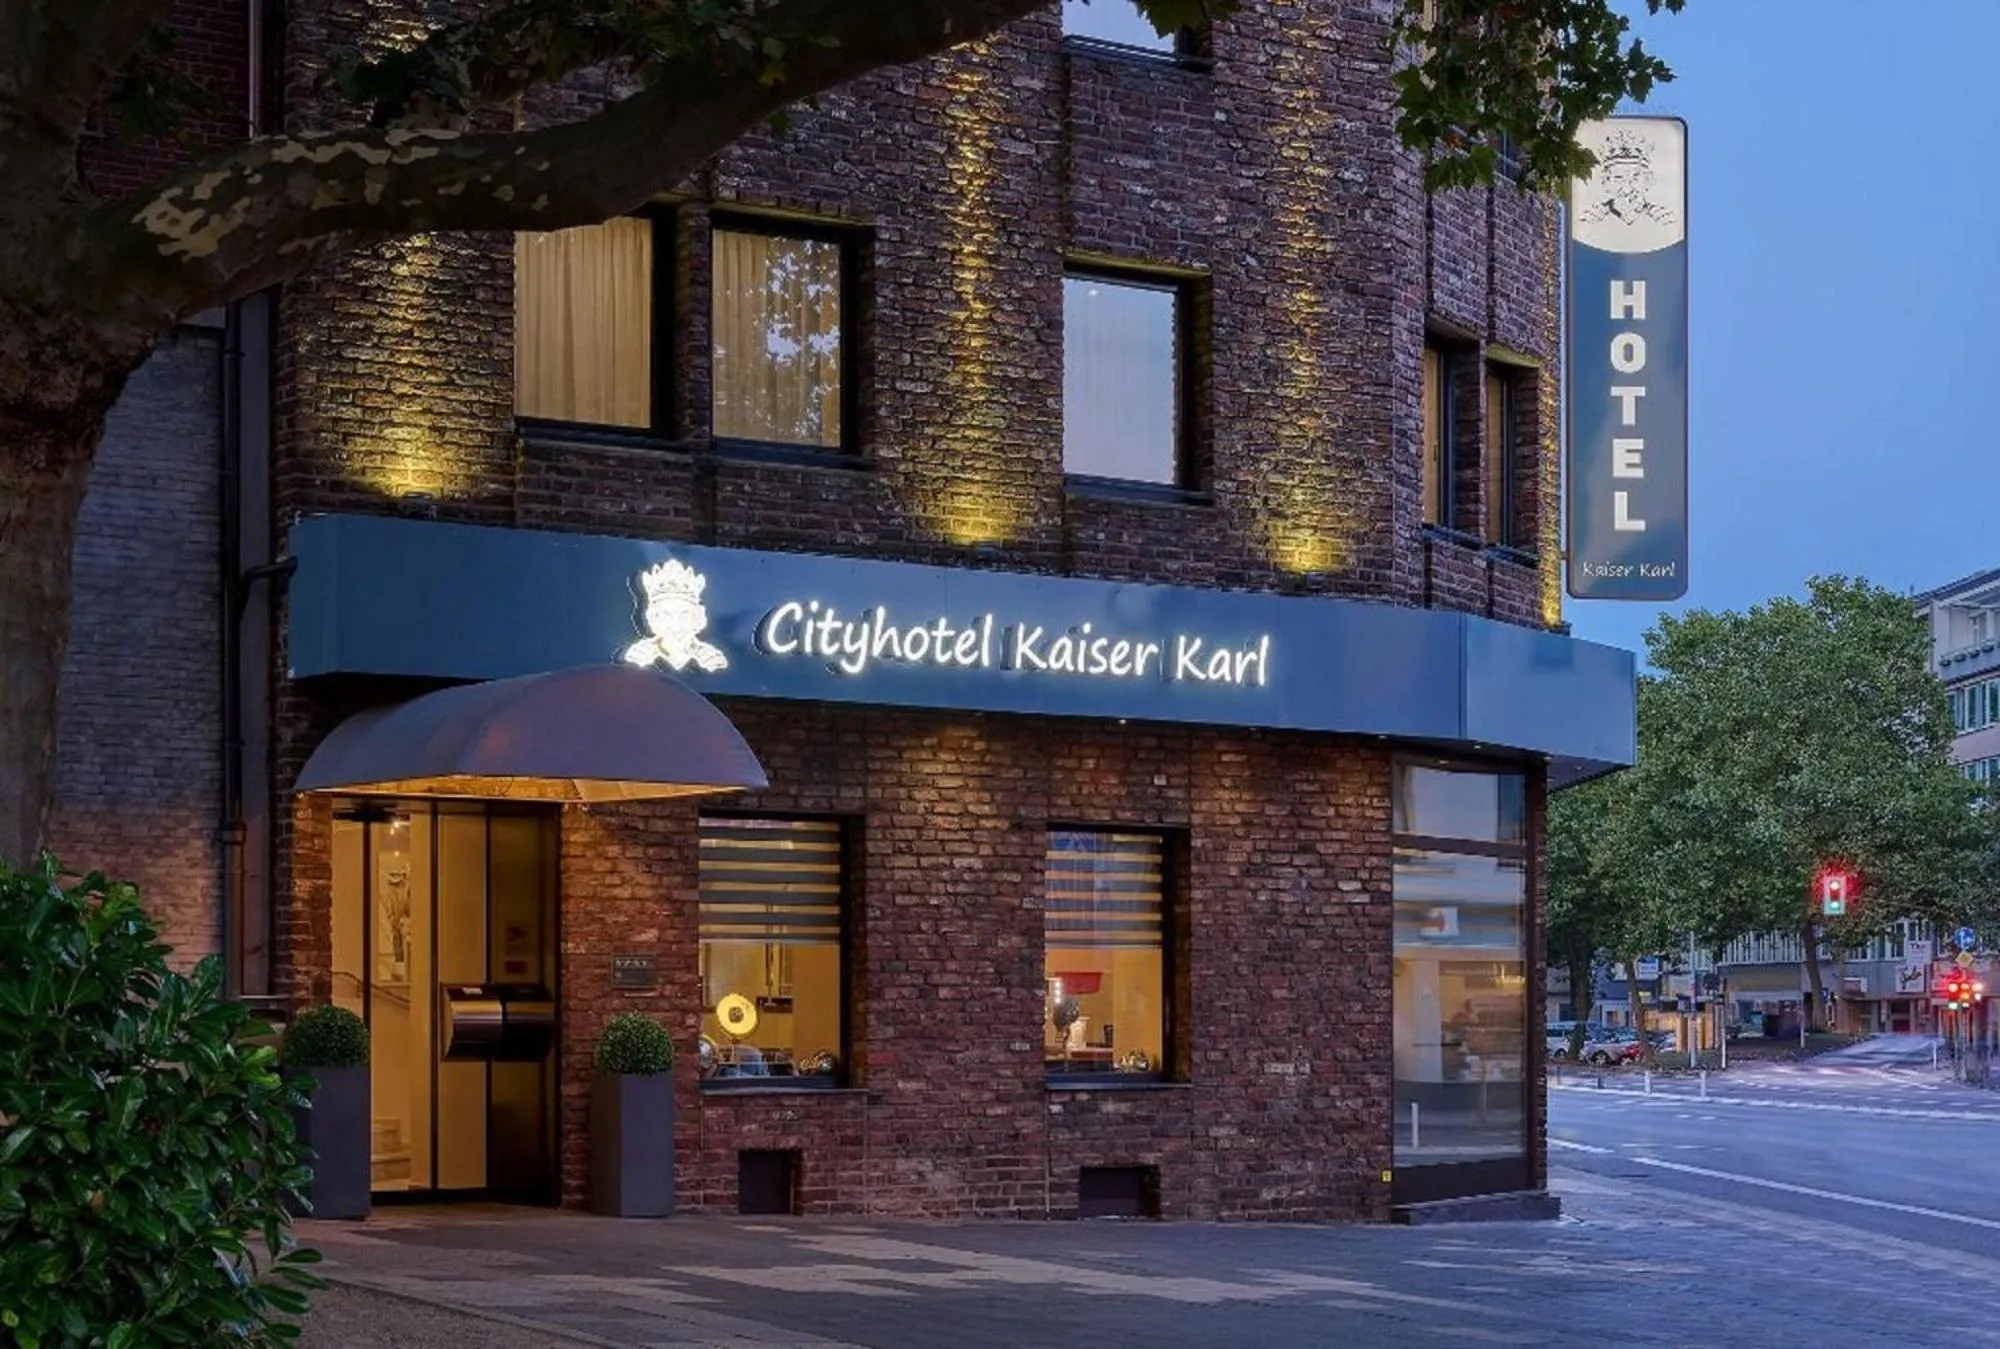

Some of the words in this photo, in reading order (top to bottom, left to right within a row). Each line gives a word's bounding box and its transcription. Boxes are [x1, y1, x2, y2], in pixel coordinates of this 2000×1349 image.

[1610, 280, 1647, 532] HOTEL
[1582, 560, 1633, 577] Kaiser
[1640, 561, 1675, 577] Karl
[766, 600, 993, 674] Cityhotel
[1014, 622, 1160, 676] Kaiser
[1175, 635, 1270, 686] Karl
